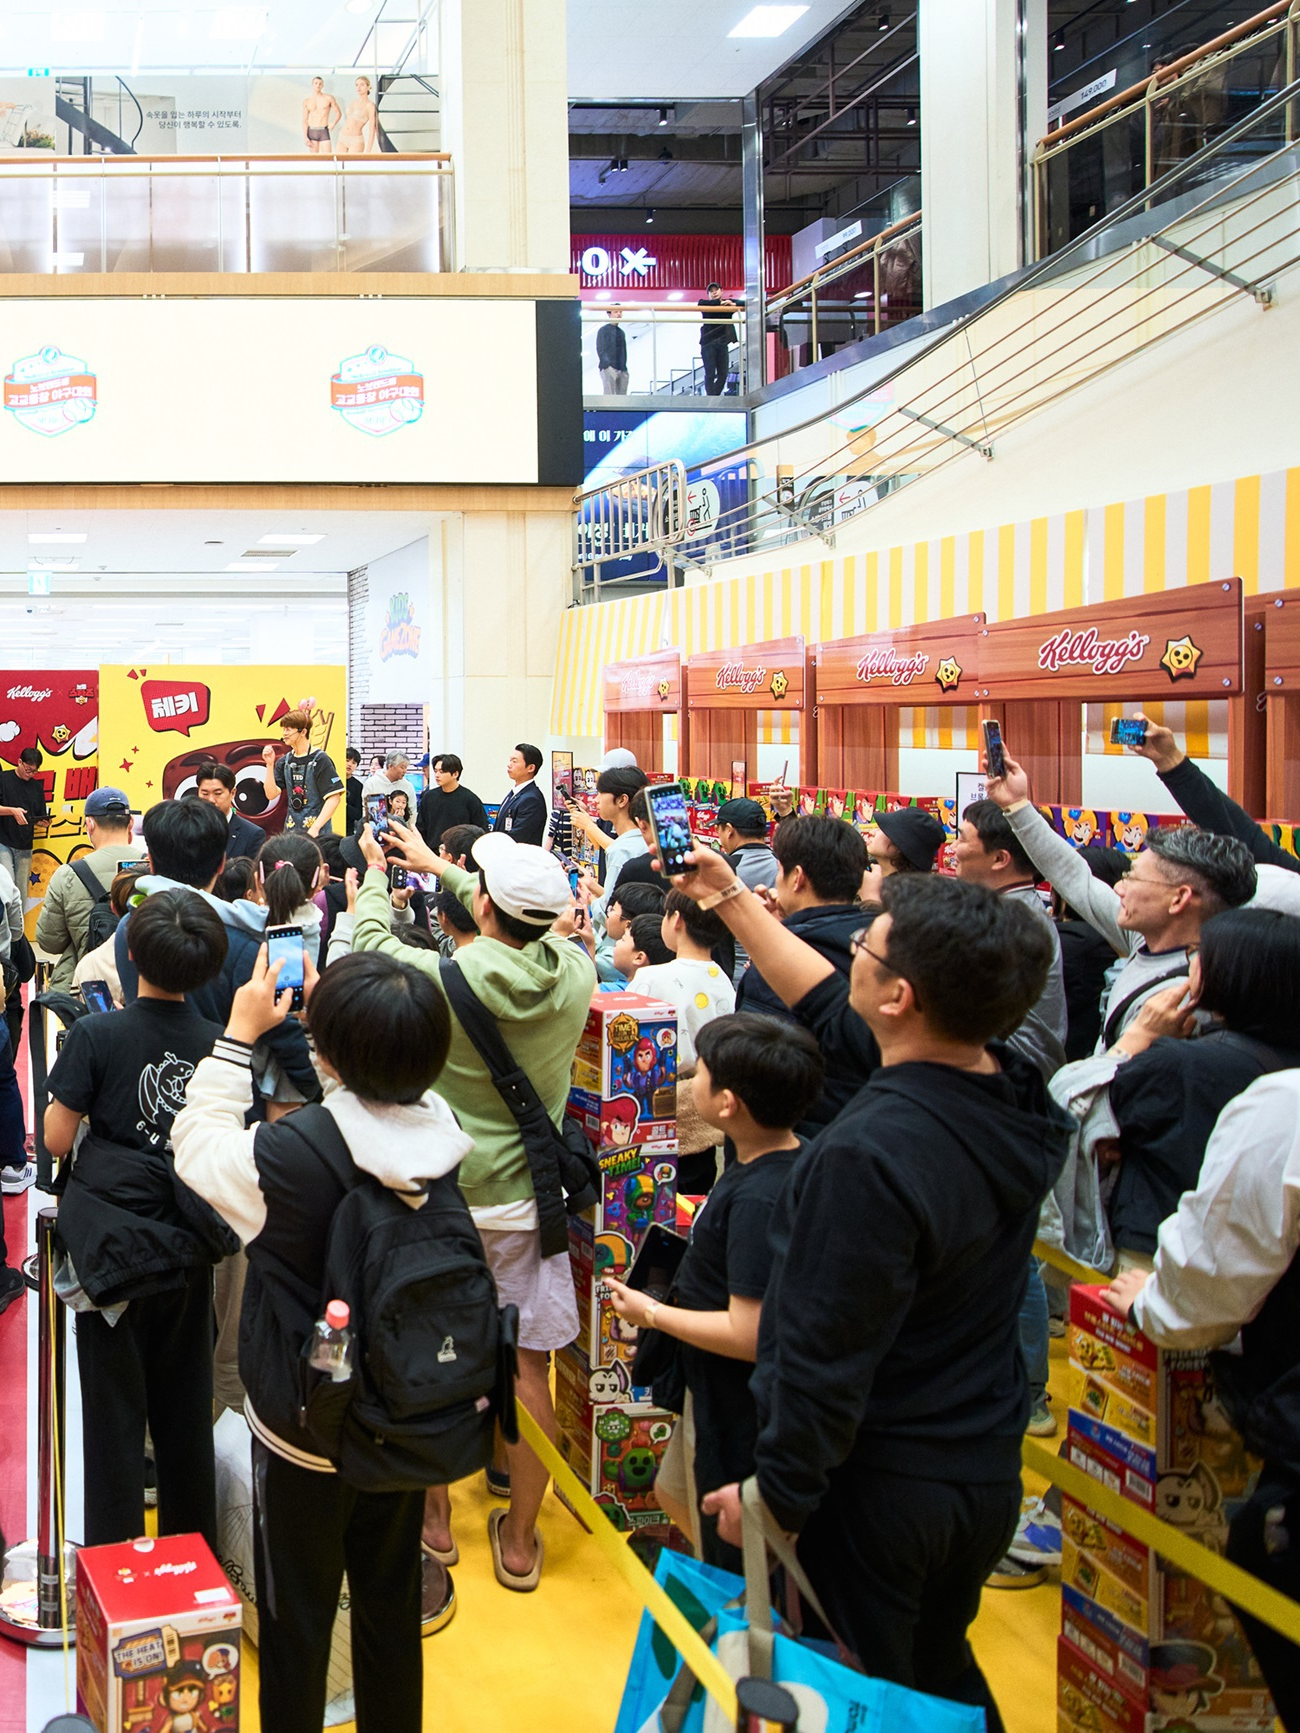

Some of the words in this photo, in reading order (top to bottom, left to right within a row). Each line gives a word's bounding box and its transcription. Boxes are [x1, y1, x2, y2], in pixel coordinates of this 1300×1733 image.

[146, 111, 168, 119] 속옷을
[170, 111, 185, 119] 입는
[187, 111, 210, 119] 하루의
[212, 110, 242, 119] 시작부터
[159, 121, 181, 129] 당신이
[183, 121, 206, 129] 행복할
[207, 121, 215, 129] 수
[584, 430, 595, 442] 에
[599, 430, 611, 442] 이
[1039, 628, 1148, 674] Kellogg's
[857, 648, 928, 685] Kellogg's
[716, 662, 766, 693] Kellogg's
[7, 685, 52, 702] Kellogg's
[599, 1148, 638, 1170] SNEAKY
[608, 1156, 641, 1178] TIME!
[117, 1649, 134, 1662] THE
[137, 1641, 162, 1655] HEAT
[133, 1657, 142, 1667] IS
